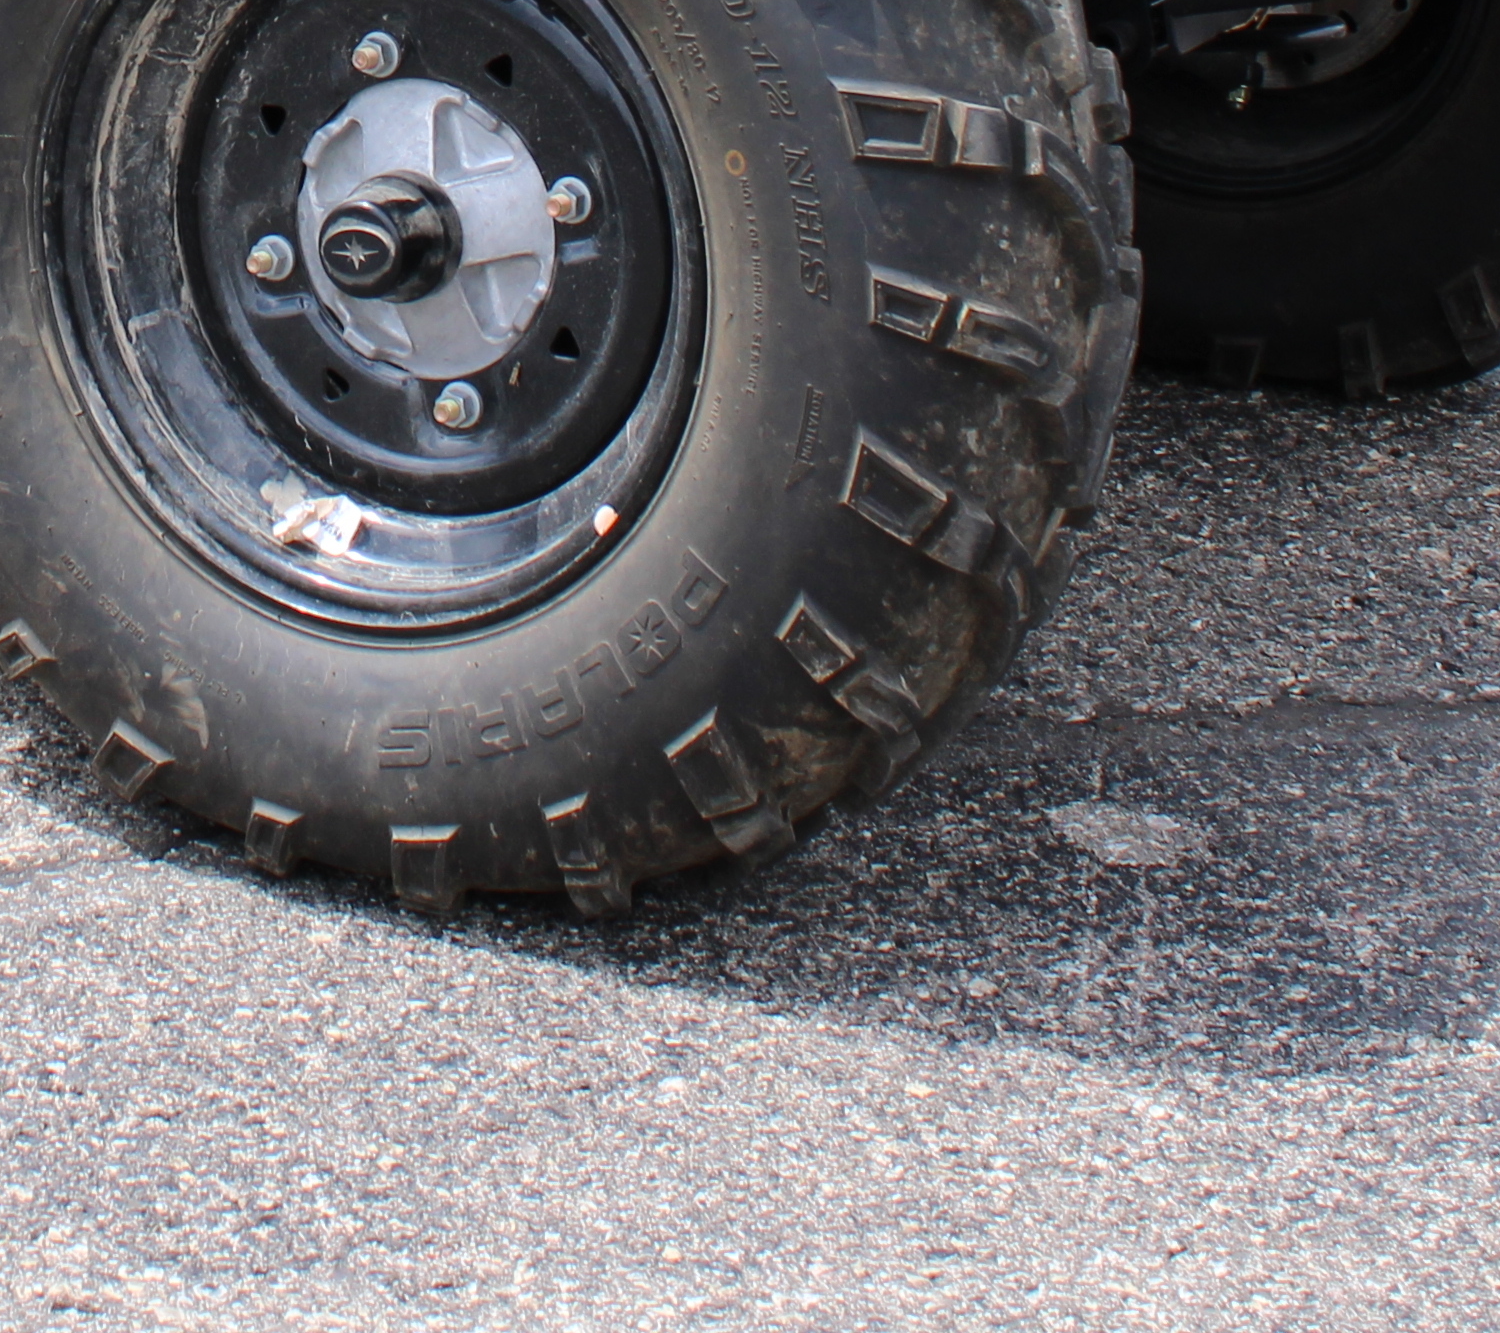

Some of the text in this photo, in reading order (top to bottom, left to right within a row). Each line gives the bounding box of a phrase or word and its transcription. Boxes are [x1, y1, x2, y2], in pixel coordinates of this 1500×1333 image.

[751, 255, 764, 326] HIGHWAY
[746, 332, 763, 397] SERVICE
[59, 553, 94, 591] NYLON
[97, 594, 149, 644] TUBELESS
[377, 545, 730, 771] POLARIS
